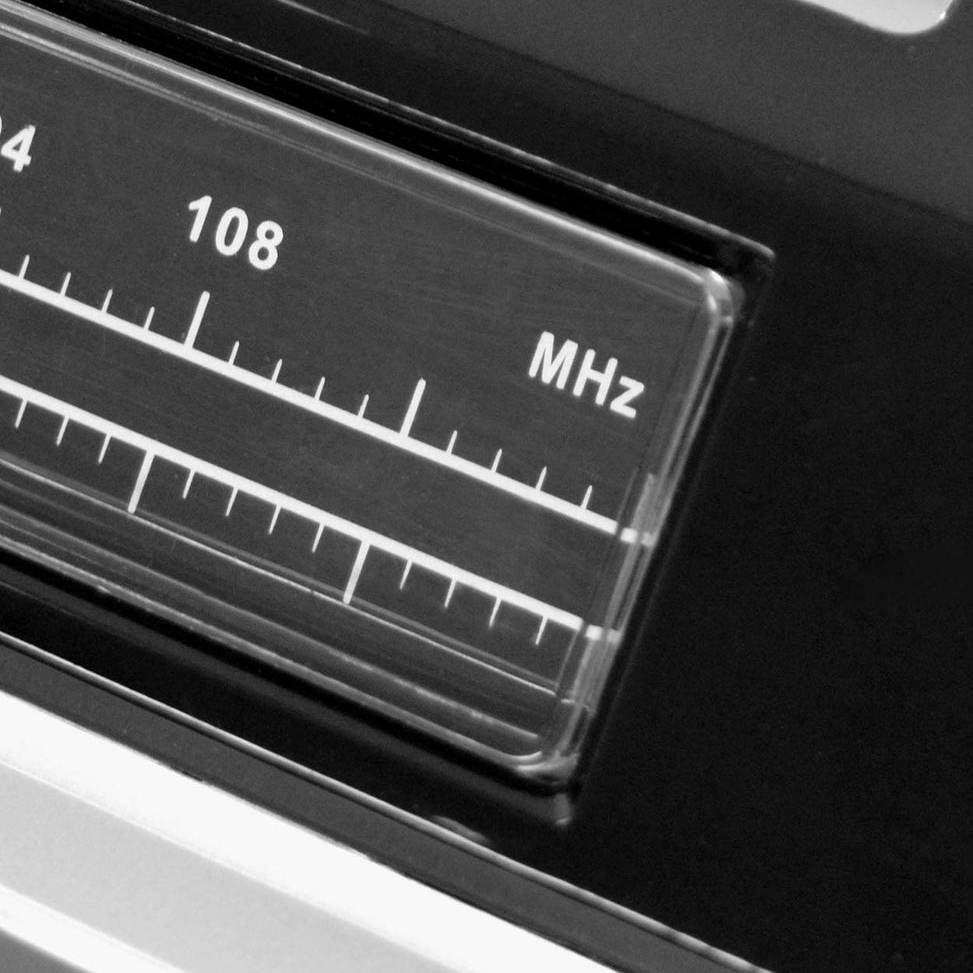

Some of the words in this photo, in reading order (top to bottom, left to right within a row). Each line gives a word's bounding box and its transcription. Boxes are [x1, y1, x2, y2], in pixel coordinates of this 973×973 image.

[0, 114, 37, 174] 4
[187, 194, 284, 271] 108
[527, 330, 646, 420] MHz
